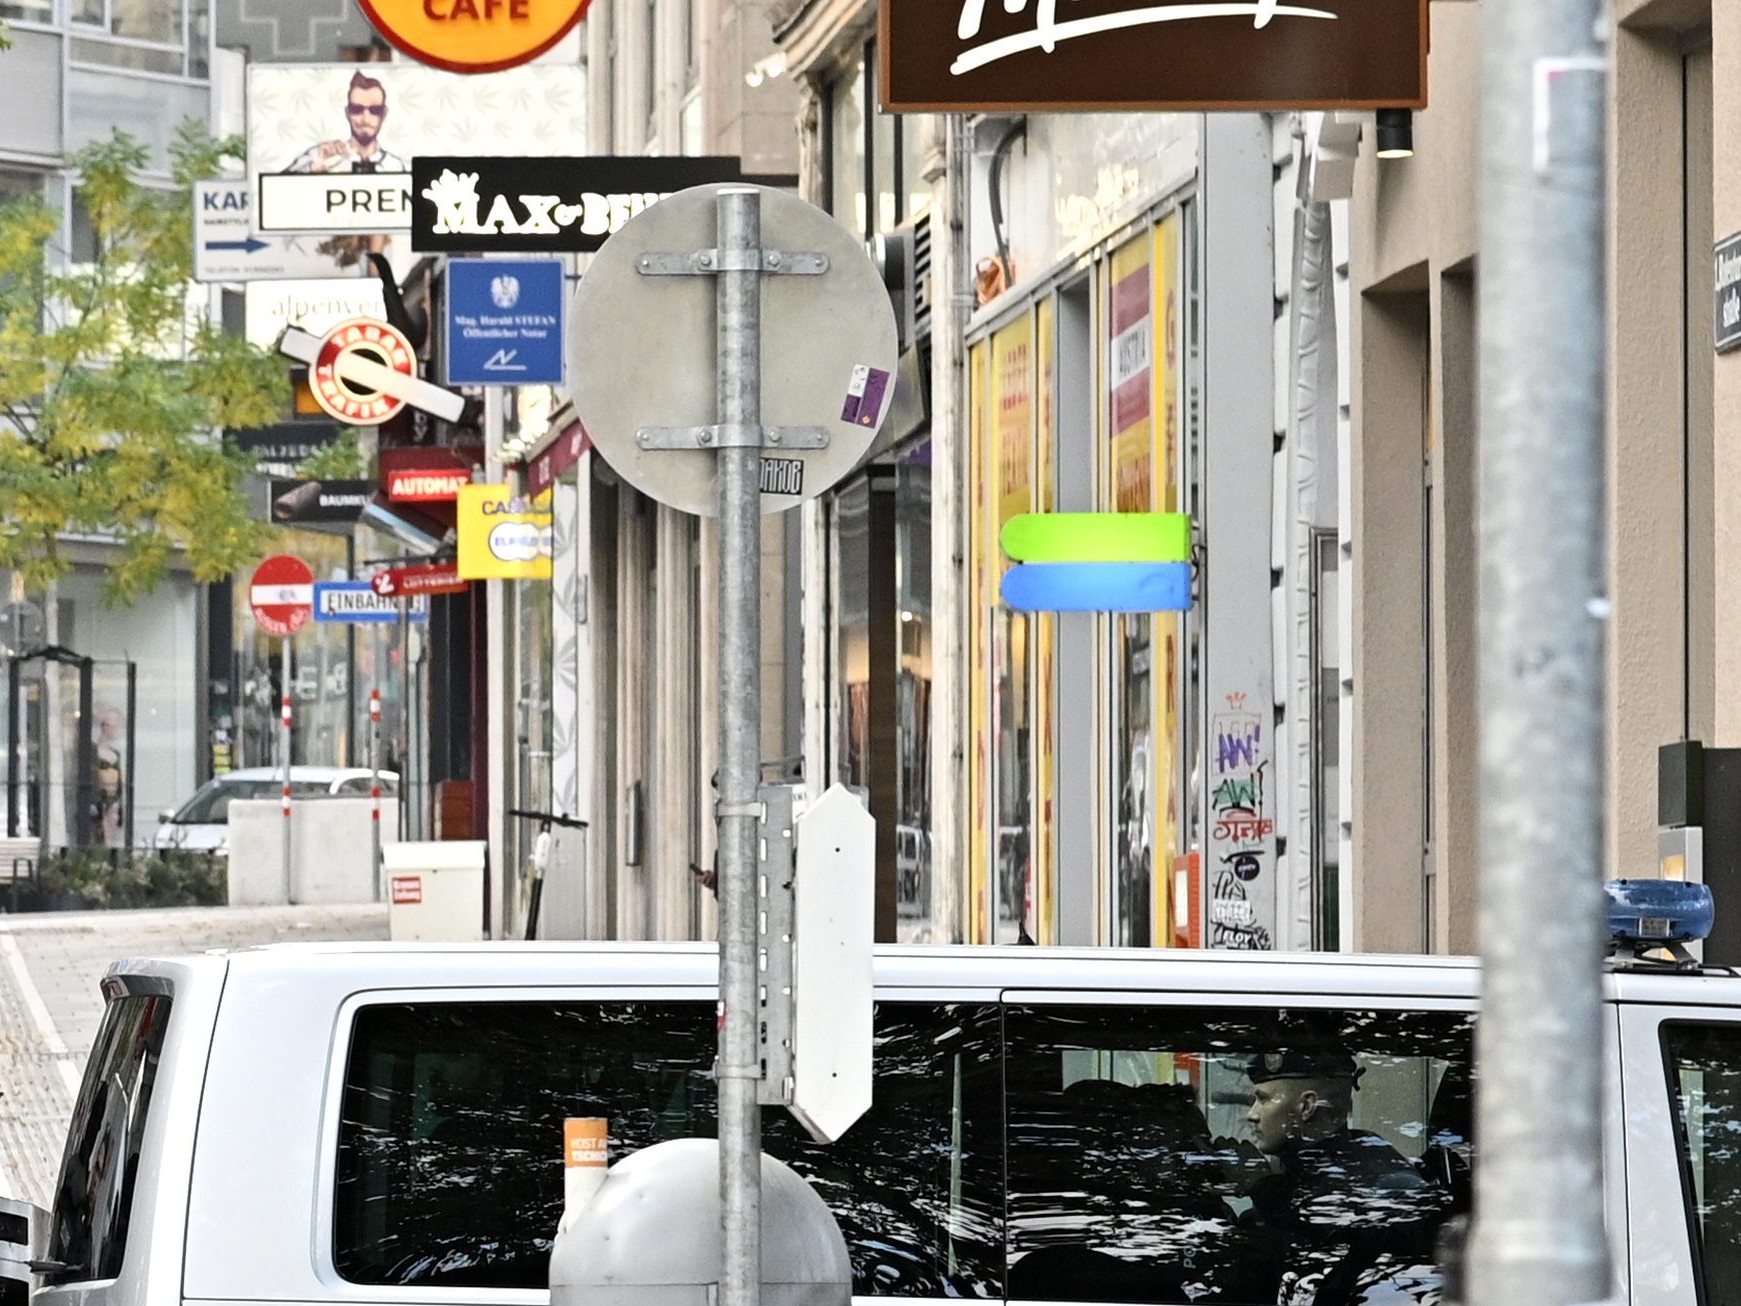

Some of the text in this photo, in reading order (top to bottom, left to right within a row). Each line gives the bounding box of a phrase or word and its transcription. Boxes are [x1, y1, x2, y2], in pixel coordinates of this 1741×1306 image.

[272, 295, 382, 322] alpenver
[328, 323, 411, 366] TABAK
[317, 363, 392, 420] TRAFIK
[391, 476, 468, 496] AUTOMAT
